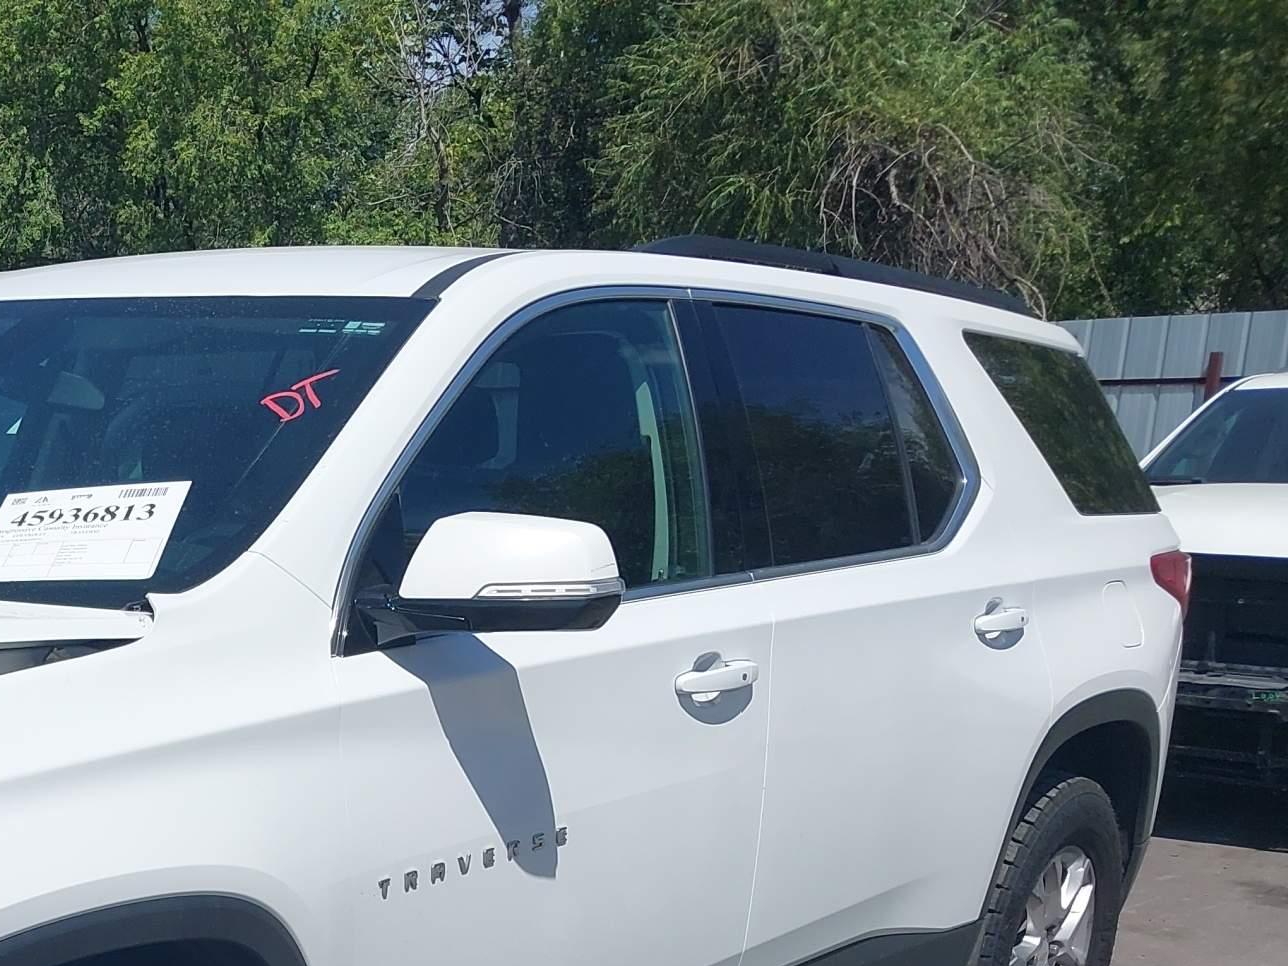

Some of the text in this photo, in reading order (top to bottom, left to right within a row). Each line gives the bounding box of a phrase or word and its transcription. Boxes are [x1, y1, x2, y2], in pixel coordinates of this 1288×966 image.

[260, 369, 340, 422] DT
[11, 503, 156, 527] 45936813
[378, 827, 567, 899] TRAVERSE
